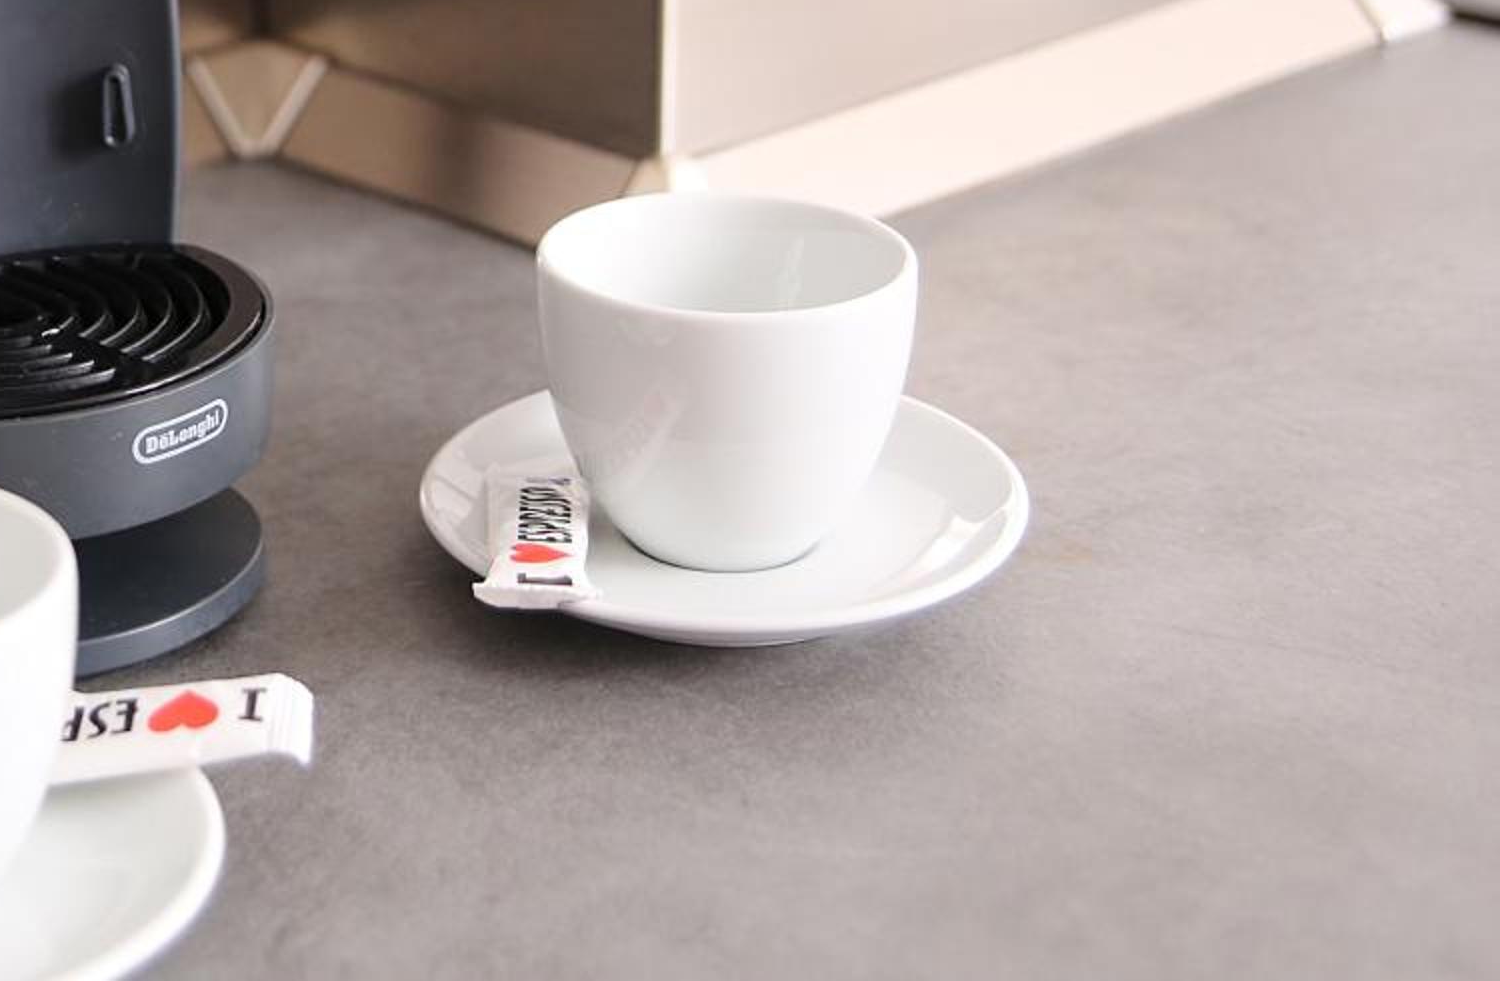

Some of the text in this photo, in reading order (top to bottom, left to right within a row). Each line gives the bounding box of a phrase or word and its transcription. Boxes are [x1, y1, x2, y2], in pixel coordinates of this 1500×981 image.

[517, 485, 573, 544] ESPRESSO
[517, 572, 573, 587] I
[237, 687, 268, 722] I
